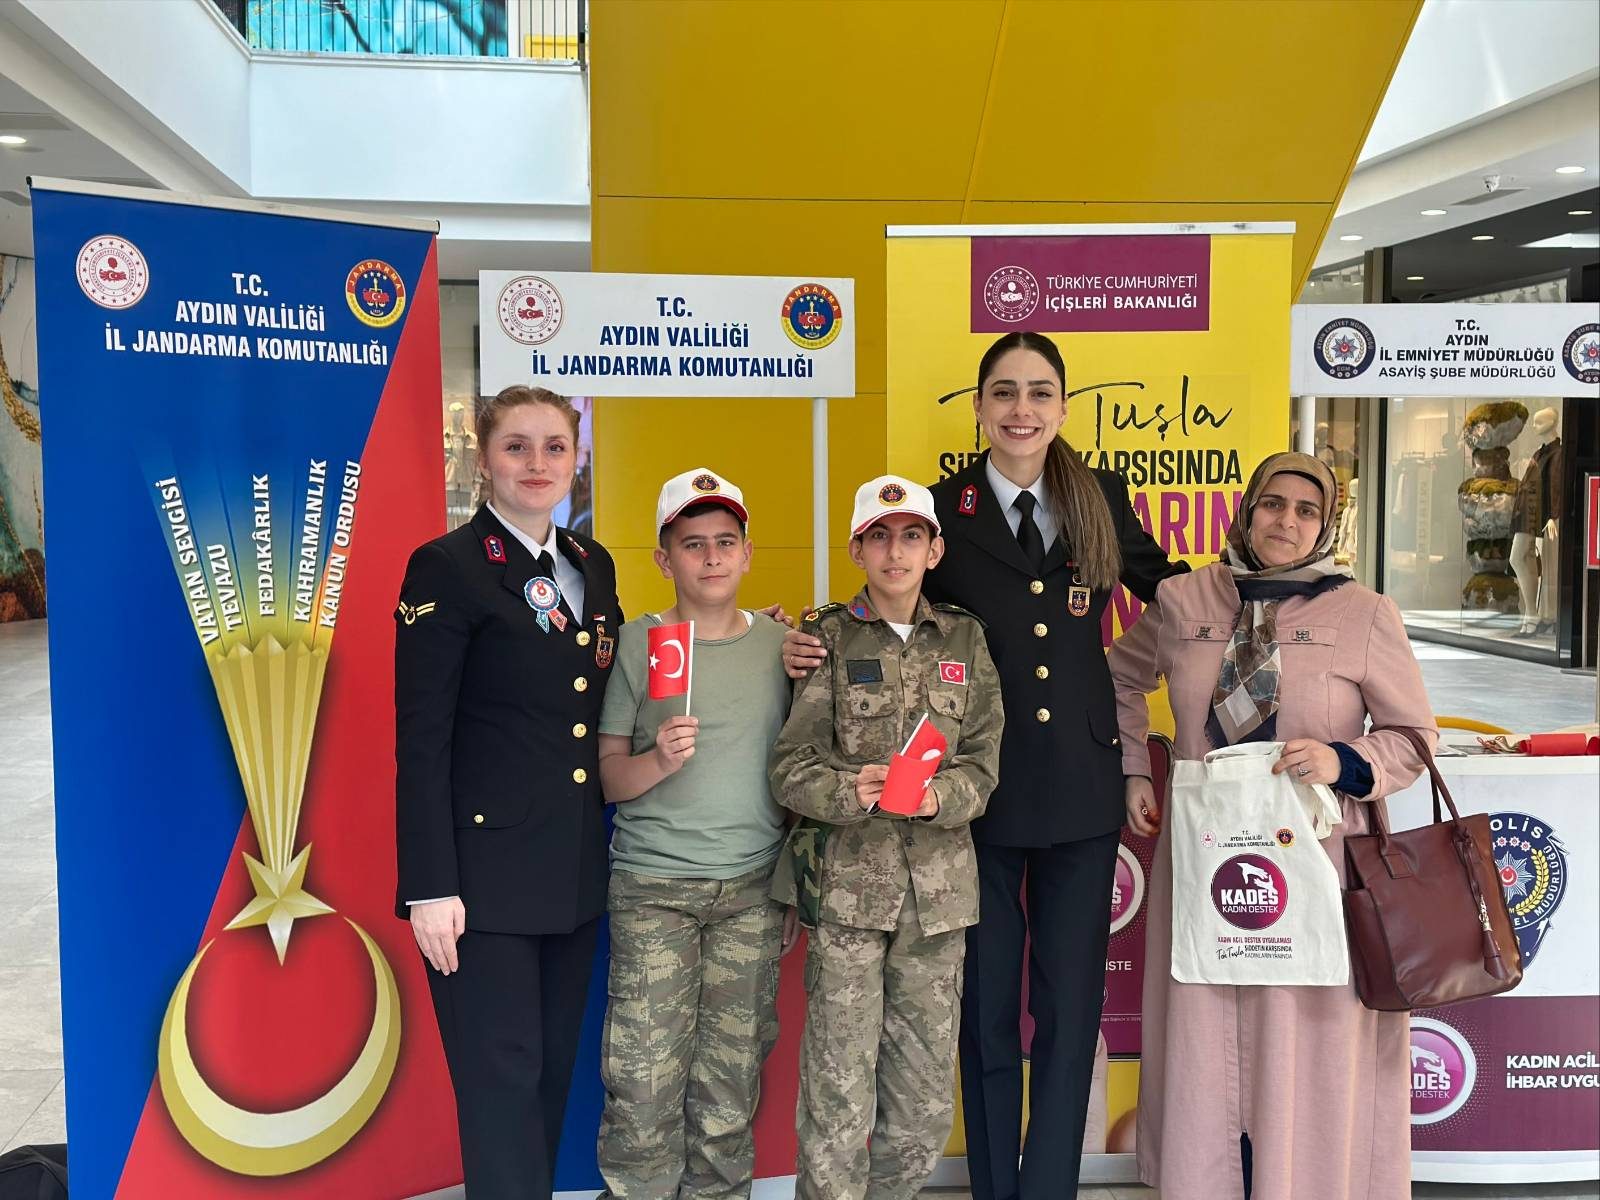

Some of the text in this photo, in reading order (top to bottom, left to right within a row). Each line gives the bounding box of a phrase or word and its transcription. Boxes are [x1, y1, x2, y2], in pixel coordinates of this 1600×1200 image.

[232, 273, 268, 296] T.C.
[349, 262, 402, 289] JANDARMA
[1046, 273, 1198, 289] TÜRKİYE CUMHURİYETİ
[656, 296, 693, 318] T.C.
[784, 286, 839, 311] JANDARMA
[1045, 293, 1198, 313] İÇİŞLERİ BAKANLIĞI
[175, 301, 326, 332] AYDIN VALİLİĞİ
[1455, 319, 1480, 331] T.C.
[105, 322, 389, 366] İL JANDARMA KOMUTANLIĞI
[599, 322, 749, 348] AYDIN VALİLİĞİ
[1445, 334, 1489, 346] AYDIN
[532, 350, 814, 378] İL JANDARMA KOMUTANLIĞI
[1380, 346, 1555, 362] İL EMNİYET MÜDÜRLÜĞÜ
[1378, 364, 1556, 380] ASAYİŞ ŞUBE MÜDÜRLÜĞÜ
[1068, 375, 1233, 450] Tuşla
[251, 474, 276, 617] FEDAKÂRLIK
[293, 458, 327, 622] KAHRAMANLIK
[319, 460, 362, 629] KANUN ORDUSU
[155, 476, 220, 646] VATAN SEVGİSİ
[206, 543, 243, 632] TEVAZU
[1490, 817, 1543, 839] OLİS
[1534, 845, 1560, 917] MÜDÜRLÜĞÜ
[1221, 888, 1279, 905] KADES
[1222, 905, 1279, 913] KADIN DESTEK
[1506, 1051, 1600, 1069] KADIN ACİL
[1506, 1072, 1558, 1089] İHBAR
[1415, 1090, 1451, 1099] DESTEK
